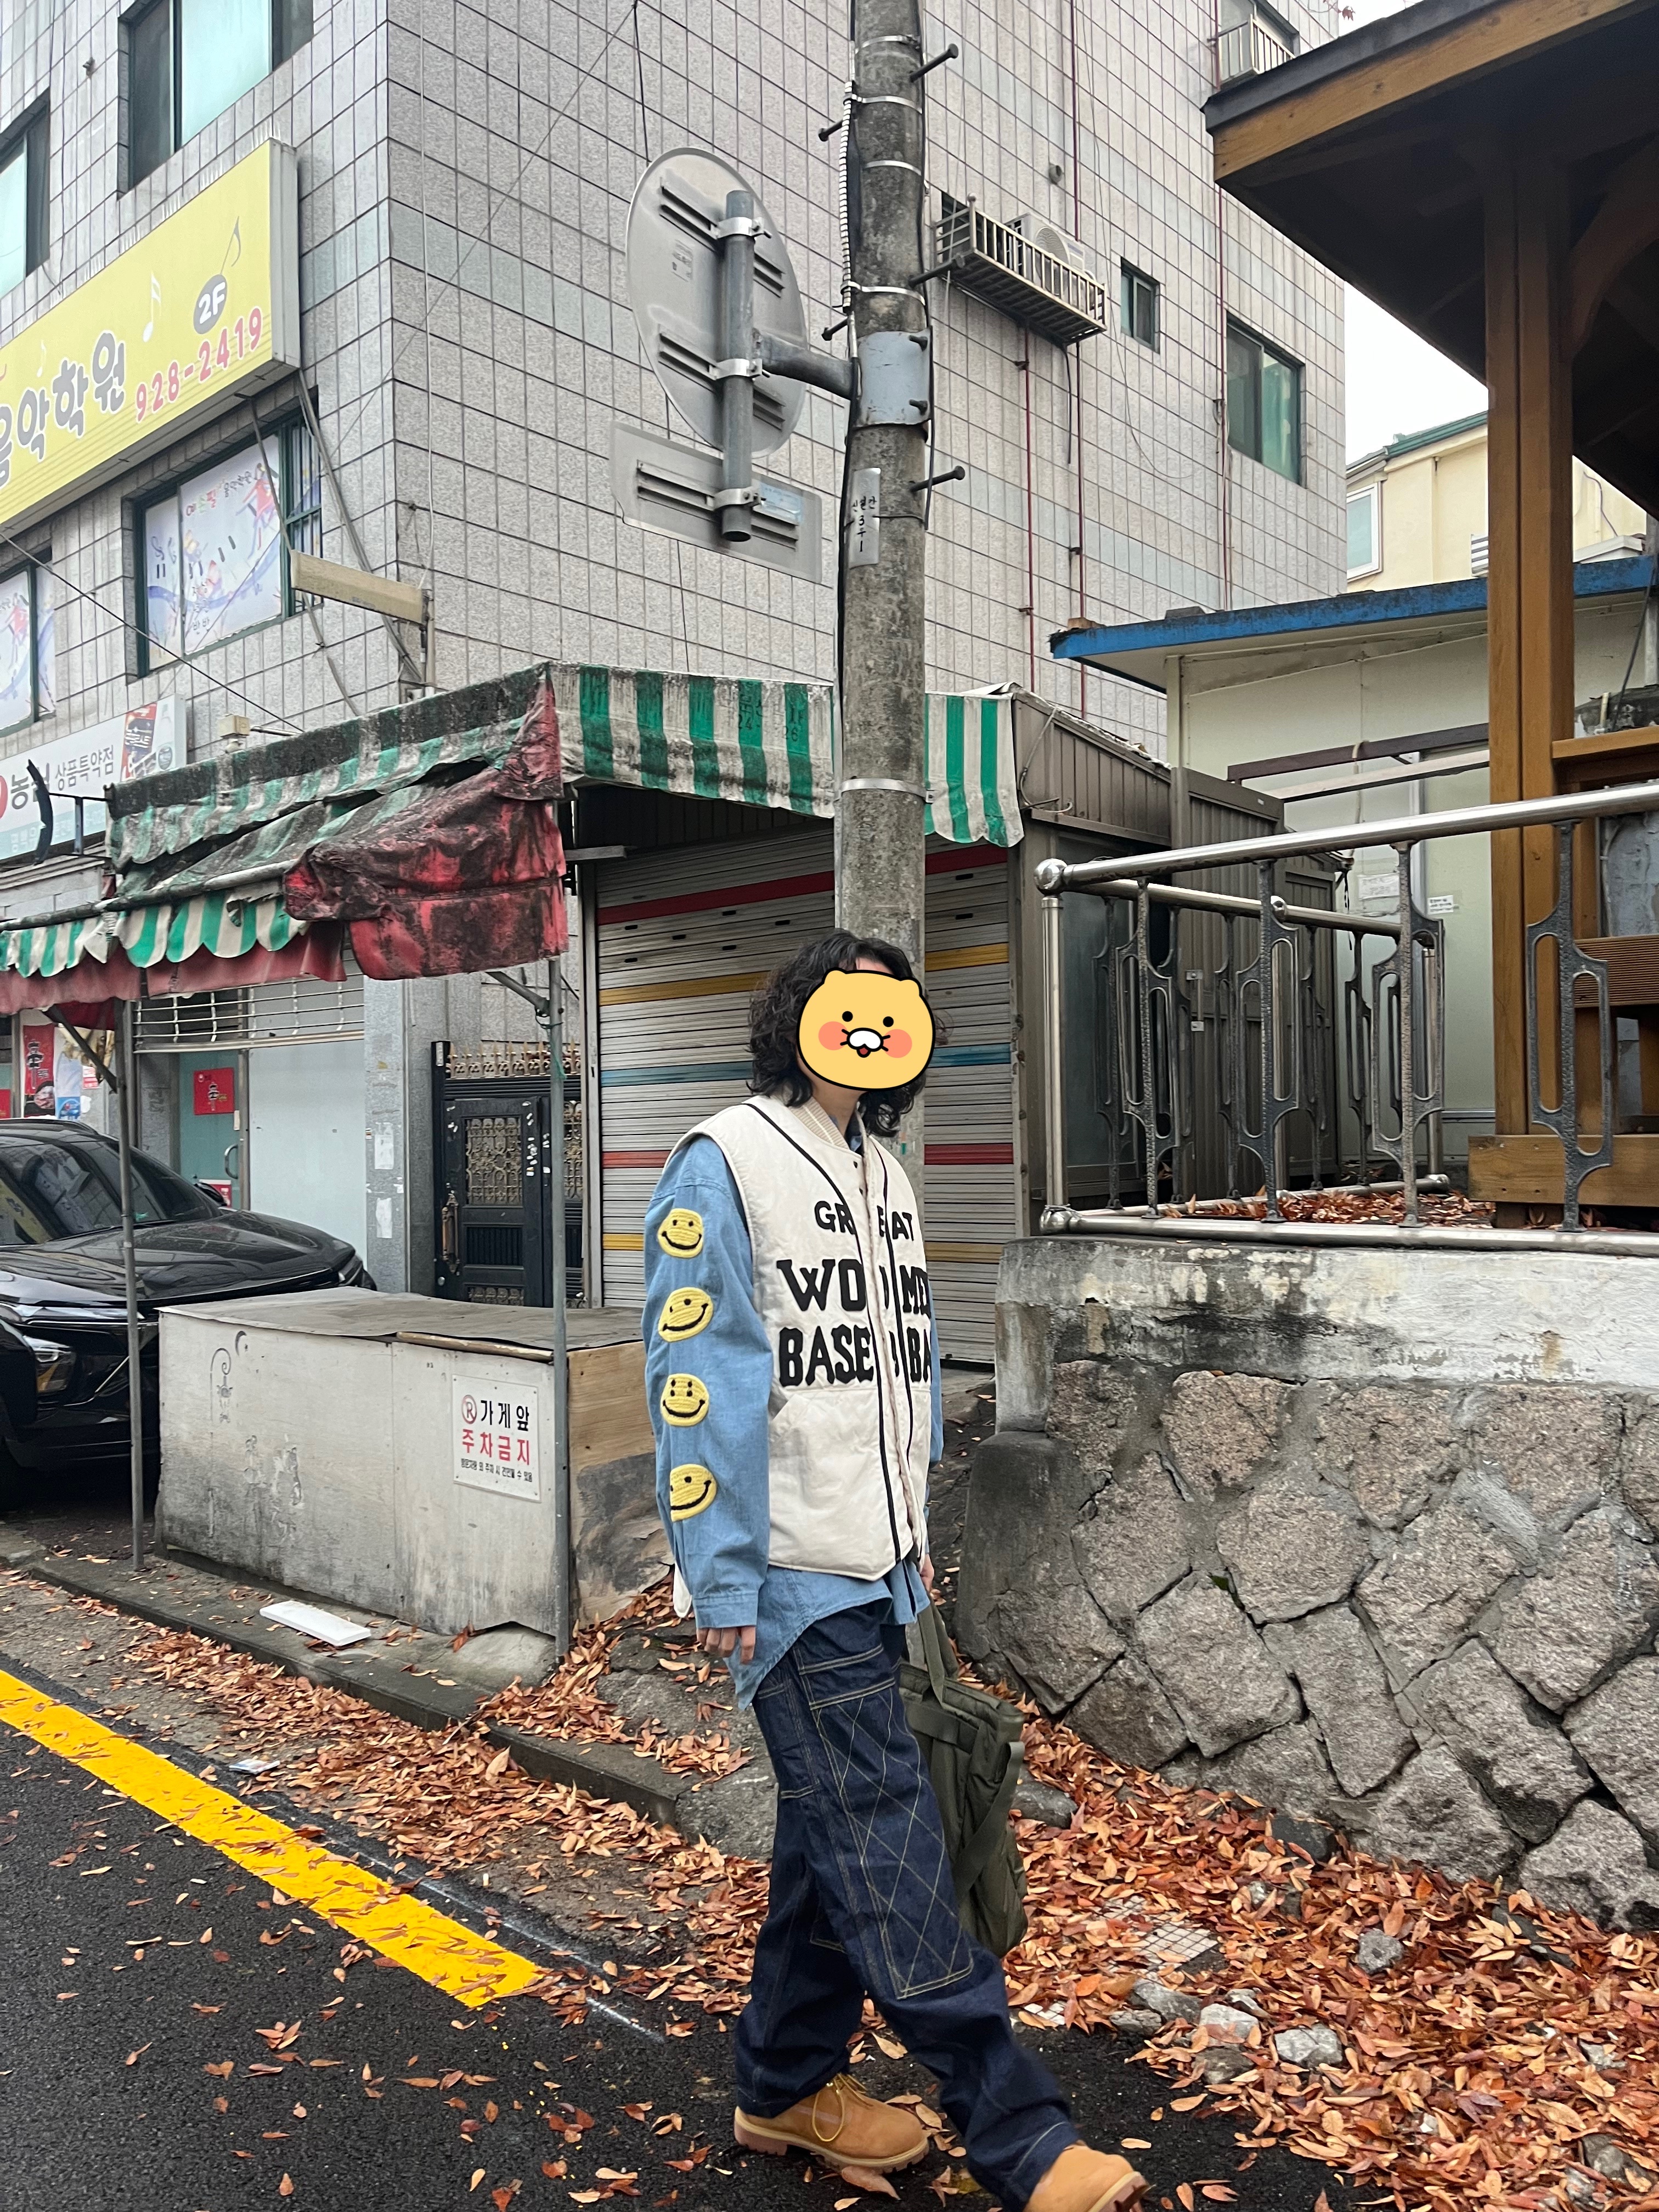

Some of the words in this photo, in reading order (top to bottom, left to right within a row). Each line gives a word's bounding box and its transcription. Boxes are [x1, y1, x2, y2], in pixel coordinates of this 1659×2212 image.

[199, 281, 225, 324] 2F
[136, 307, 262, 422] 928-2419
[55, 744, 114, 791] 상품특약점
[462, 1429, 529, 1466] 주차금지
